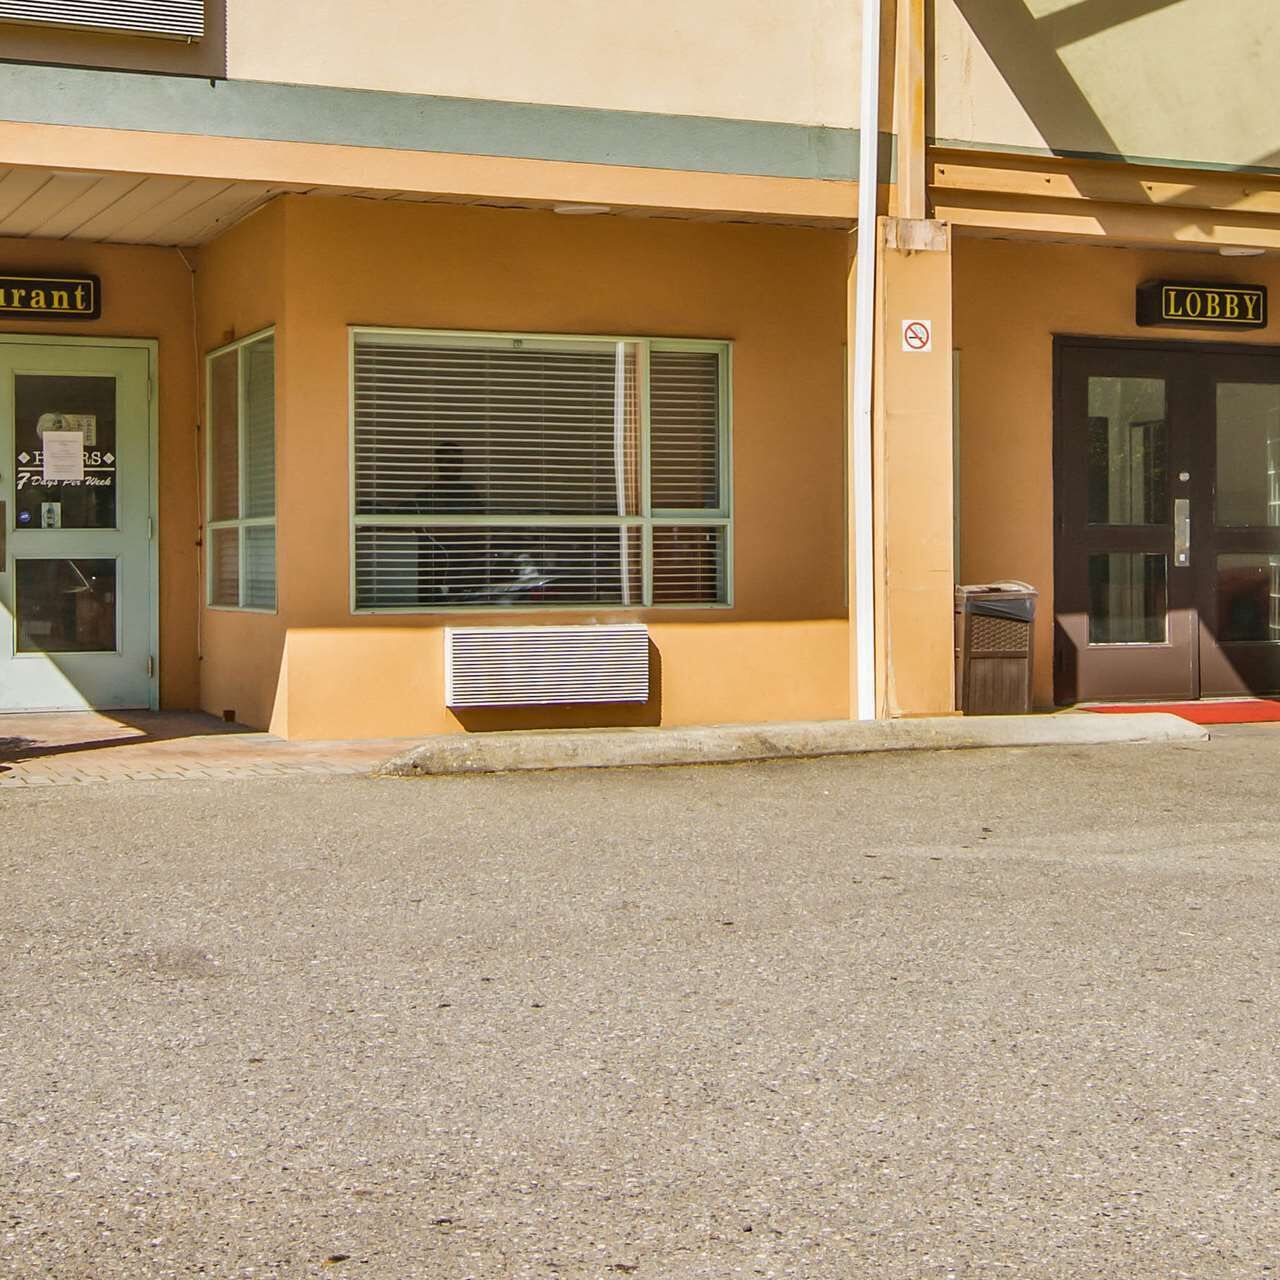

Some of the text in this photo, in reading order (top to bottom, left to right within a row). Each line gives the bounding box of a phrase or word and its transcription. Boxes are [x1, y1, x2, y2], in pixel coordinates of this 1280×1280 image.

[1168, 291, 1258, 319] LOBBY
[32, 451, 102, 465] HRS
[17, 472, 31, 490] 7
[84, 476, 113, 487] Week
